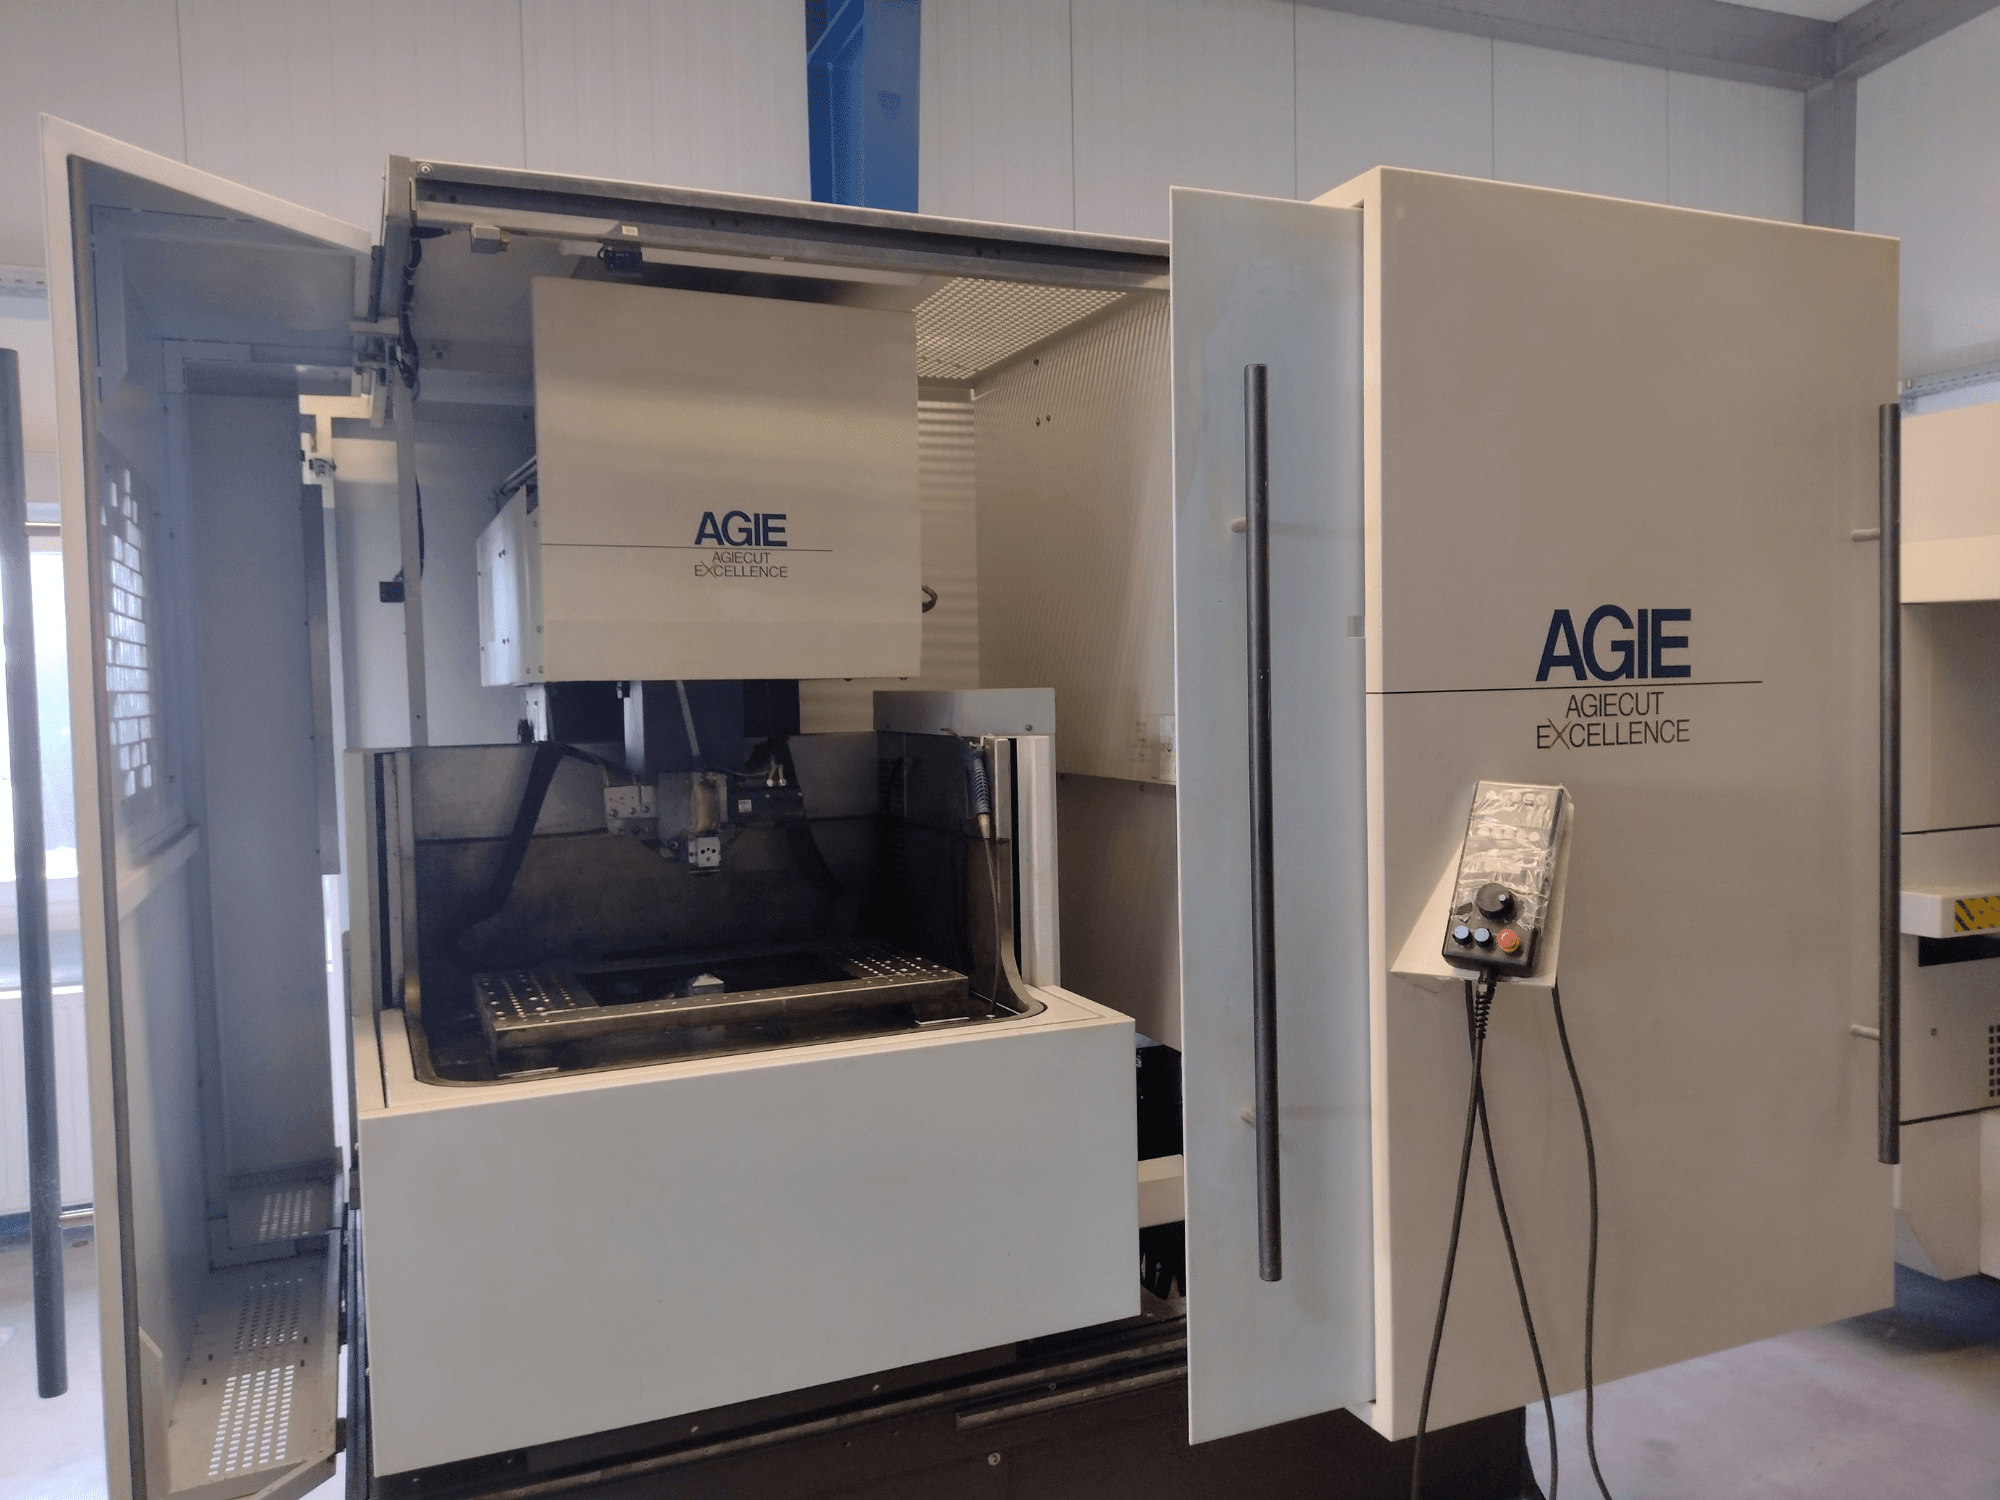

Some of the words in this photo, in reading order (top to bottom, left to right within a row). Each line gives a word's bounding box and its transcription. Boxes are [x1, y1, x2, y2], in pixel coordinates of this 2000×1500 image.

[694, 510, 788, 547] AGIE
[694, 561, 788, 578] EXCELLENCE
[712, 551, 772, 564] AGIECUT
[1535, 604, 1691, 682] AGIE
[1566, 691, 1664, 718] AGIECUT
[1537, 718, 1690, 750] EXCELLENCE
